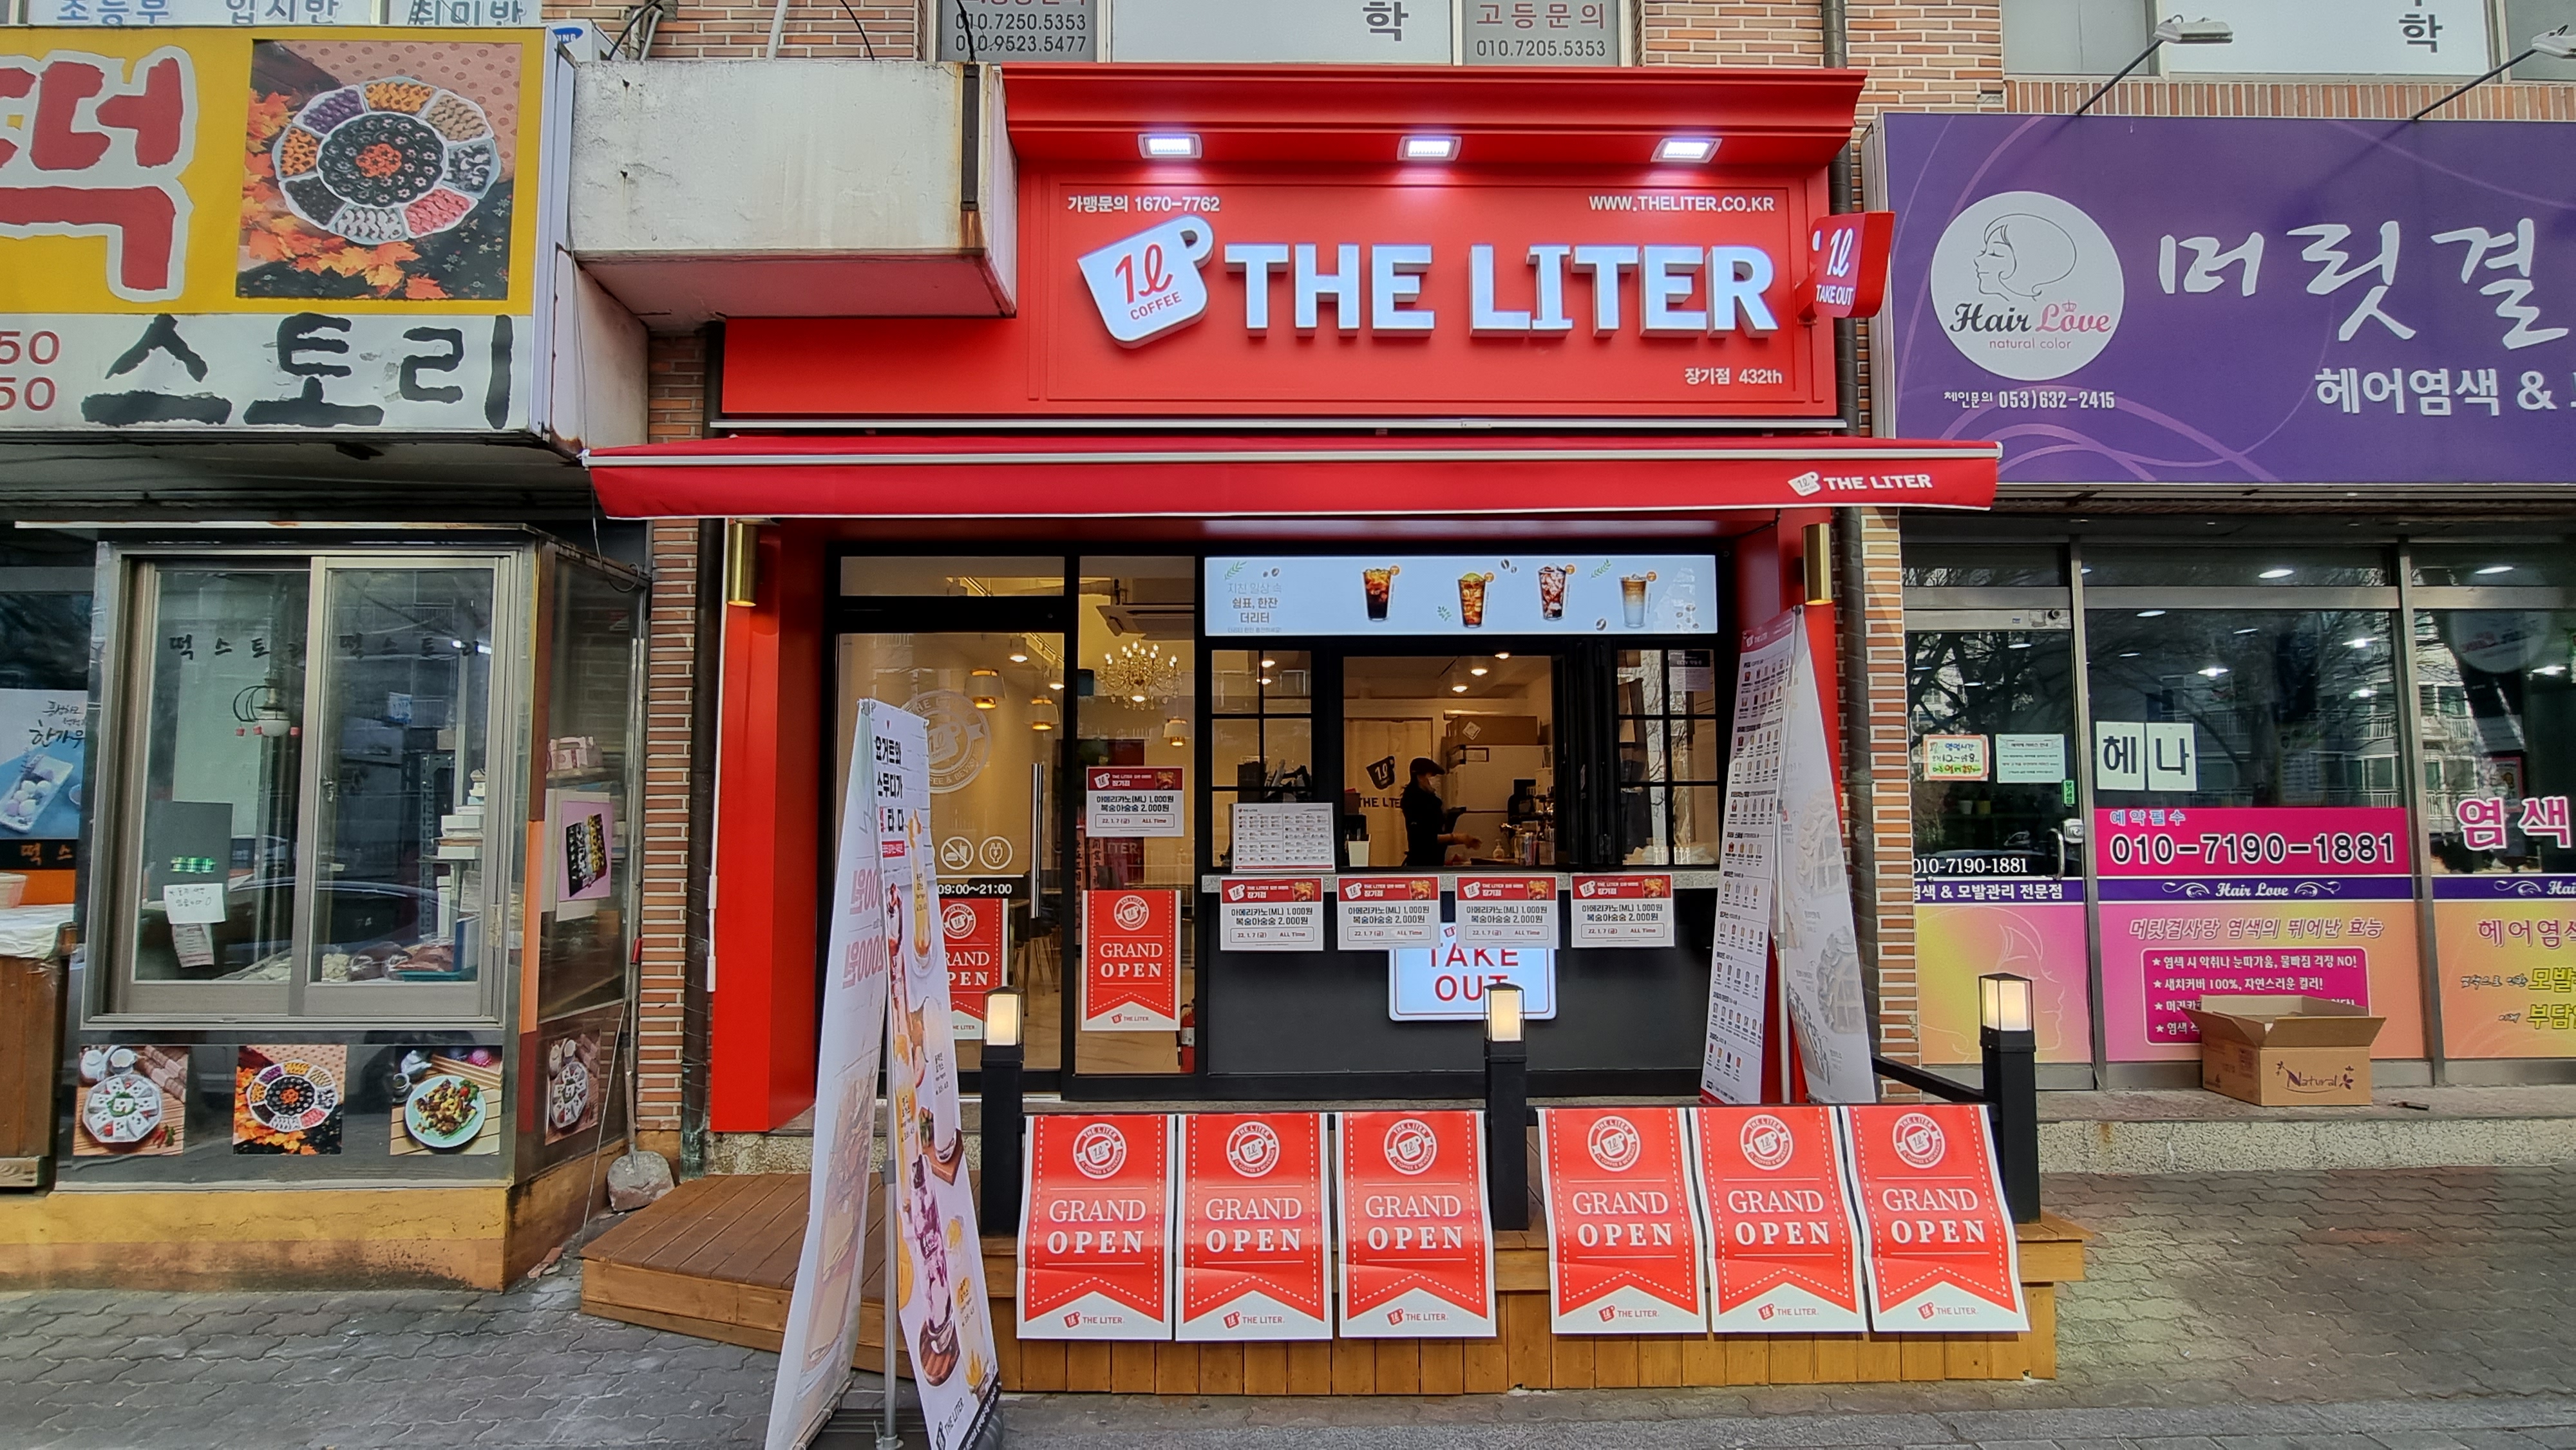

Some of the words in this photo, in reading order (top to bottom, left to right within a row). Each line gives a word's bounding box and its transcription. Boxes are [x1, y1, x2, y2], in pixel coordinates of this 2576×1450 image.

[956, 13, 1086, 30] 010.7250.5353
[1362, 1, 1409, 42] 학
[1476, 3, 1605, 30] 고등문의
[956, 35, 1087, 52] 00.9523.5477
[2398, 13, 2444, 53] 학
[1476, 39, 1606, 57] 010.7205.5353
[1067, 195, 1129, 212] 가맹문의
[1135, 196, 1220, 212] 1670-7762
[1589, 195, 1775, 212] WWW.THELITER.CO.KR
[1224, 243, 1435, 334] THE
[1468, 243, 1779, 336] LITER
[2159, 218, 2569, 350] 머릿결
[1815, 284, 1835, 304] TAKE
[1836, 286, 1854, 306] OUT
[1130, 291, 1182, 321] COFFEE
[1949, 303, 2032, 333] Hair
[2035, 303, 2112, 333] Love
[1989, 337, 2036, 350] natural
[2040, 337, 2072, 350] color
[80, 312, 514, 430] 스토리
[1684, 367, 1730, 386] 장기점
[1738, 367, 1783, 385] 432th
[1944, 391, 1993, 409] 체인문의
[1998, 390, 2116, 410] 053)632-2415
[2315, 367, 2499, 417] 헤어염색
[2516, 370, 2558, 411] &
[1823, 476, 1868, 491] THE
[1870, 473, 1933, 489] LITER
[1258, 596, 1278, 609] 한잔
[1240, 612, 1270, 624] 더리터
[2102, 735, 2190, 776] 헤나
[877, 771, 903, 799] 스무디가
[2110, 809, 2186, 827] 예약필수
[2456, 796, 2571, 851] 염색
[2110, 833, 2396, 865] 010-7190-1881
[1914, 858, 2028, 874] 010-7190-1881
[1940, 885, 1954, 899] &
[1957, 883, 2014, 900] 모발관리
[2020, 883, 2063, 900] 전문점
[2216, 882, 2252, 898] Hair
[2255, 882, 2289, 897] Love
[2546, 880, 2576, 896] Hai
[2128, 918, 2221, 940] 머릿결사랑
[2226, 917, 2281, 939] 염색의
[2286, 917, 2342, 939] 뛰어난
[2347, 917, 2383, 938] 효능
[1099, 943, 1163, 958] GRAND
[1100, 963, 1162, 978] OPEN
[2163, 956, 2184, 969] 염색
[2187, 956, 2197, 968] 시
[2314, 954, 2334, 968] 걱정
[2337, 954, 2358, 968] NO!
[949, 971, 989, 986] PEN
[2164, 978, 2206, 992] 새치커버
[2244, 977, 2296, 990] 자연스러운
[2528, 967, 2576, 993] 모발
[2286, 1071, 2338, 1088] Natural
[1205, 1196, 1302, 1221] GRAND
[1365, 1194, 1463, 1219] GRAND
[1572, 1190, 1669, 1215] GRAND
[1727, 1189, 1824, 1214] GRAND
[1881, 1187, 1979, 1212] GRAND
[1048, 1199, 1147, 1223] GRAND
[1205, 1228, 1302, 1252] OPEN
[1367, 1225, 1464, 1250] OPEN
[1577, 1222, 1672, 1247] OPEN
[1734, 1221, 1831, 1245] OPEN
[1891, 1219, 1986, 1243] OPEN
[1046, 1230, 1144, 1255] OPEN
[1082, 1316, 1098, 1324] THE
[1099, 1316, 1123, 1324] LITER
[1242, 1315, 1258, 1324] THE
[1259, 1315, 1283, 1324] LITER
[1405, 1312, 1421, 1321] THE
[1423, 1312, 1447, 1321] LITER
[1616, 1309, 1634, 1318] THE
[1634, 1309, 1659, 1318] LITER
[1777, 1308, 1793, 1316] THE
[1794, 1308, 1817, 1316] LITER
[1936, 1306, 1953, 1315] THE
[1954, 1306, 1977, 1315] LITER
